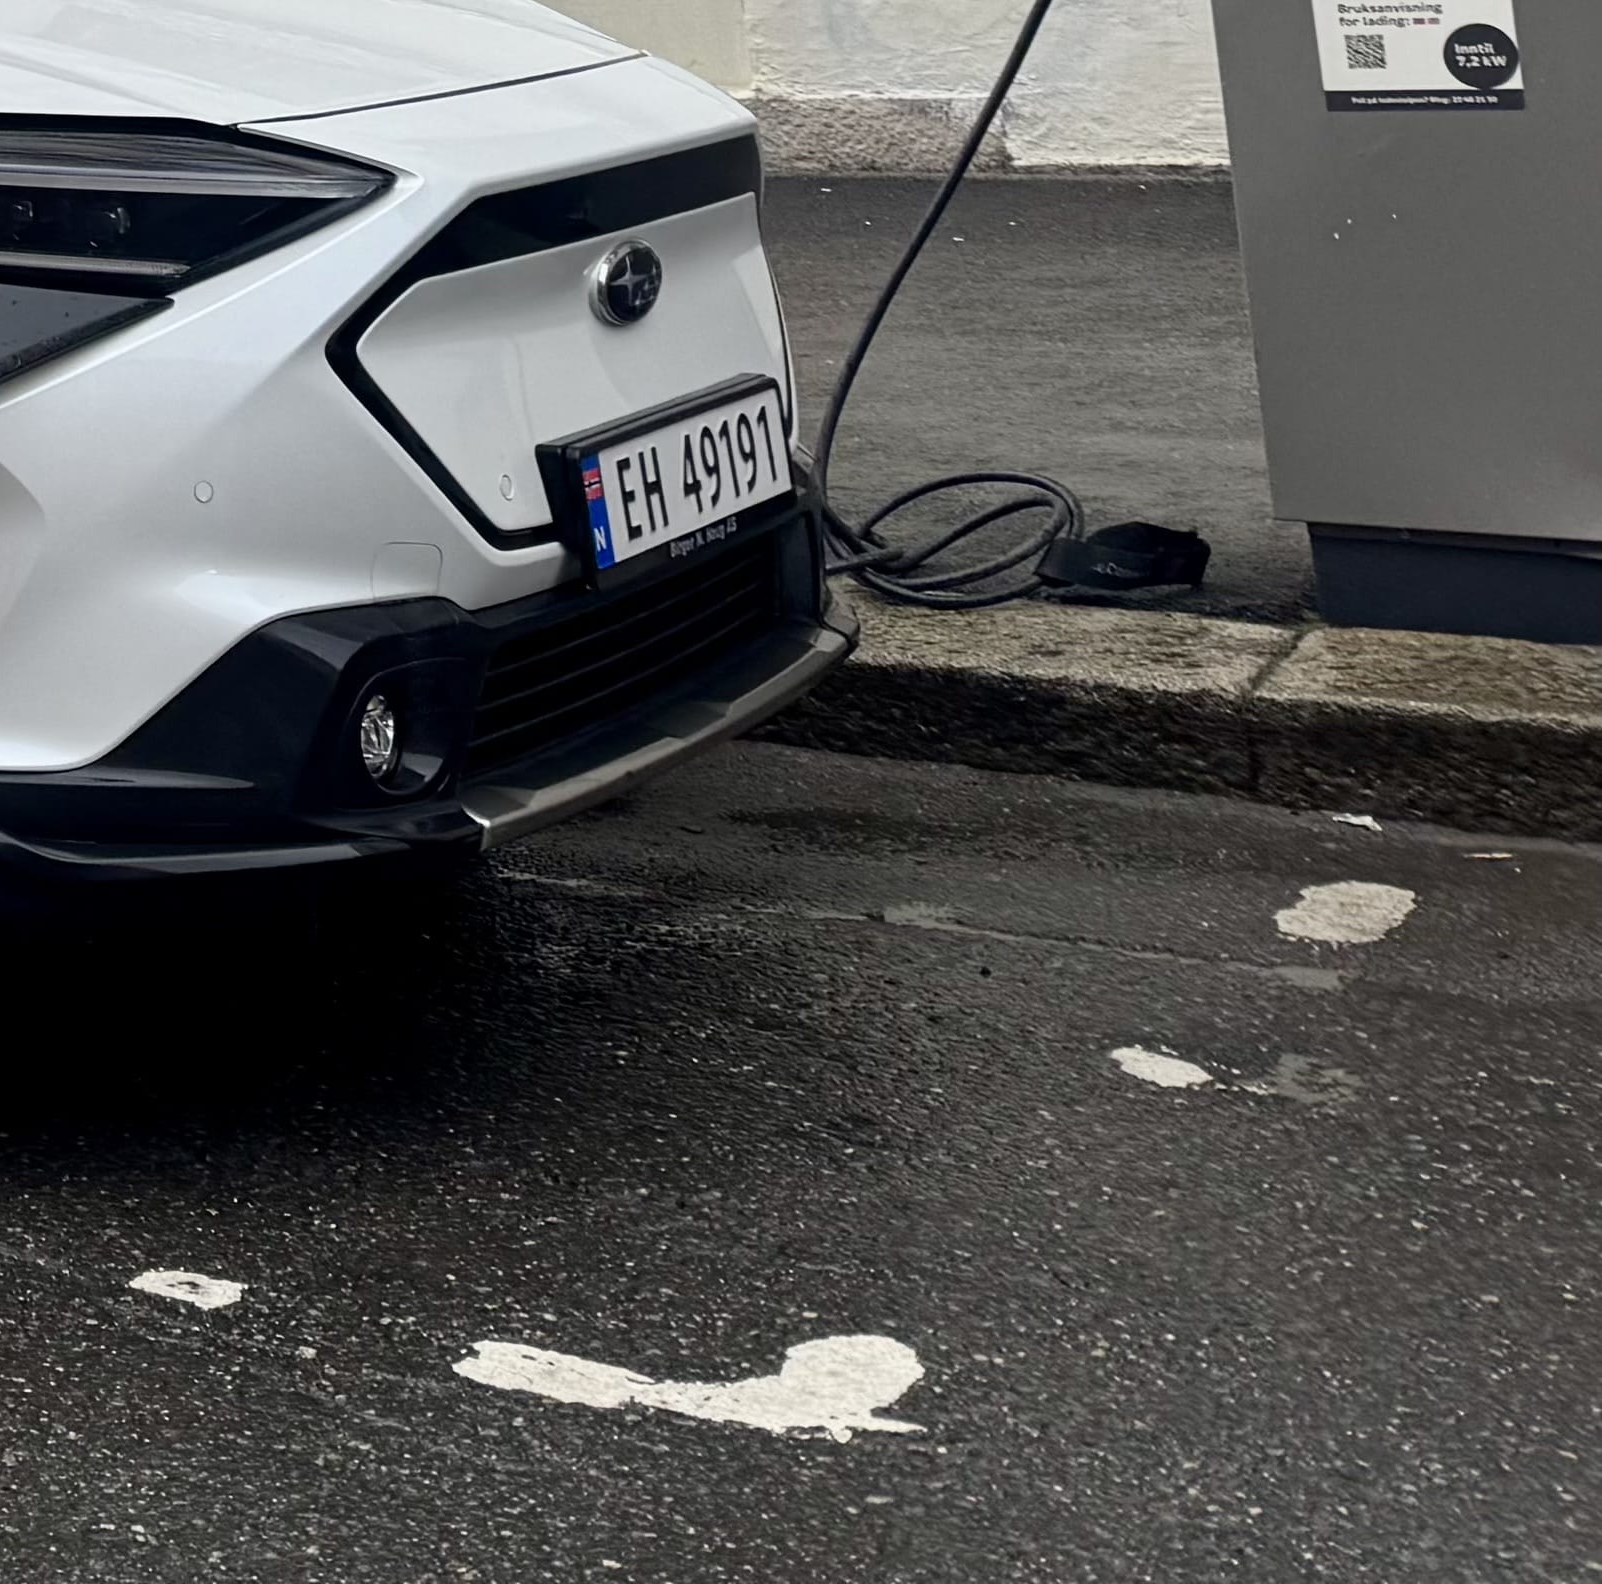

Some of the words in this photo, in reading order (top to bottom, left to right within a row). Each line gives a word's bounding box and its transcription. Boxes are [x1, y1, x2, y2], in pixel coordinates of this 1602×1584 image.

[1337, 2, 1444, 15] Bruksanvisning
[1339, 17, 1360, 27] for
[1362, 16, 1411, 28] lading:
[1453, 42, 1495, 55] Inntil
[1455, 55, 1481, 69] 7,2
[1482, 54, 1508, 68] kW
[615, 446, 670, 542] EH
[682, 405, 778, 515] 49191
[593, 524, 608, 553] N
[669, 536, 696, 559] Birger
